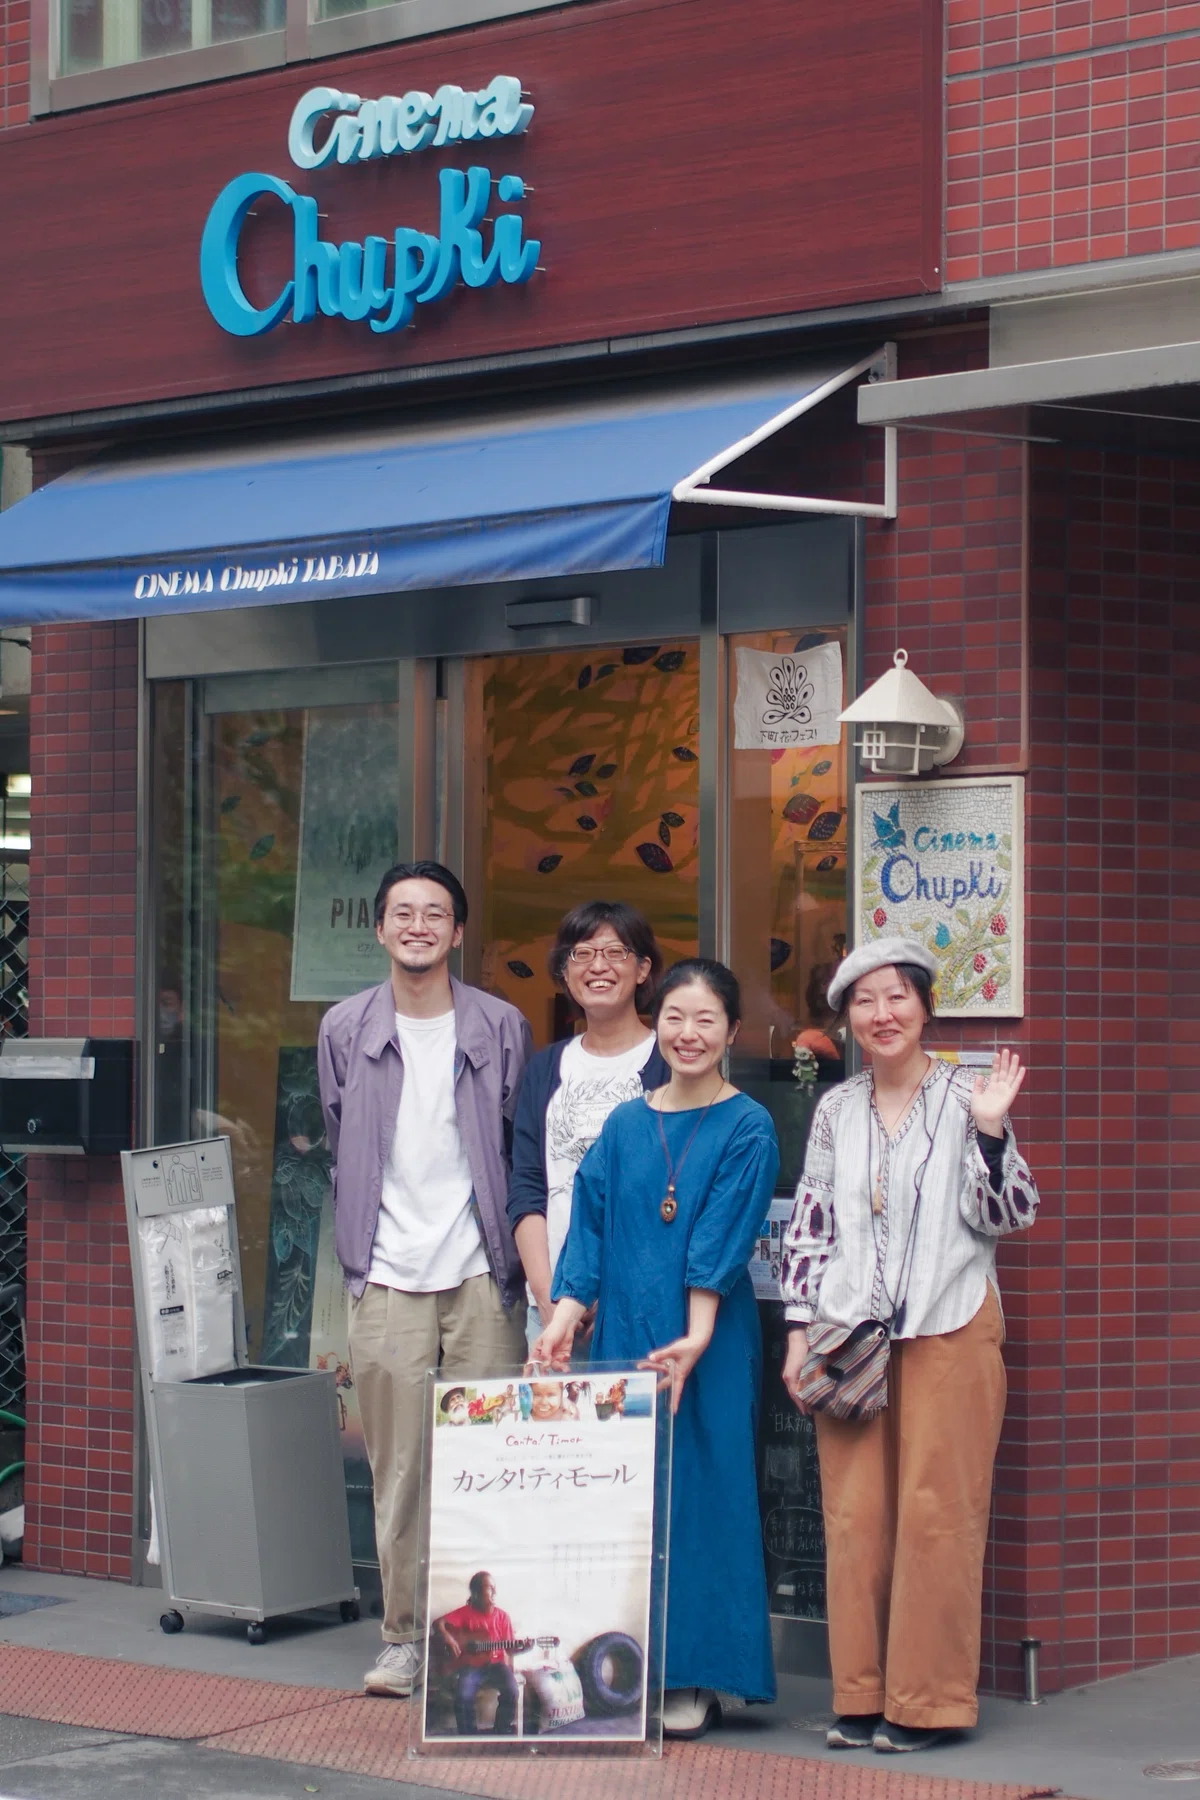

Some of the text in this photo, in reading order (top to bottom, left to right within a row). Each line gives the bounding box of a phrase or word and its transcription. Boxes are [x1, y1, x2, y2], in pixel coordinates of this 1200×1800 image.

[288, 75, 534, 170] Cinema
[134, 552, 379, 599] CINEMA Chupki TABATA
[913, 826, 1001, 852] Cinema
[330, 897, 378, 929] PIA
[548, 1433, 583, 1447] Timor
[452, 1463, 639, 1494] カンタ!ティモール
